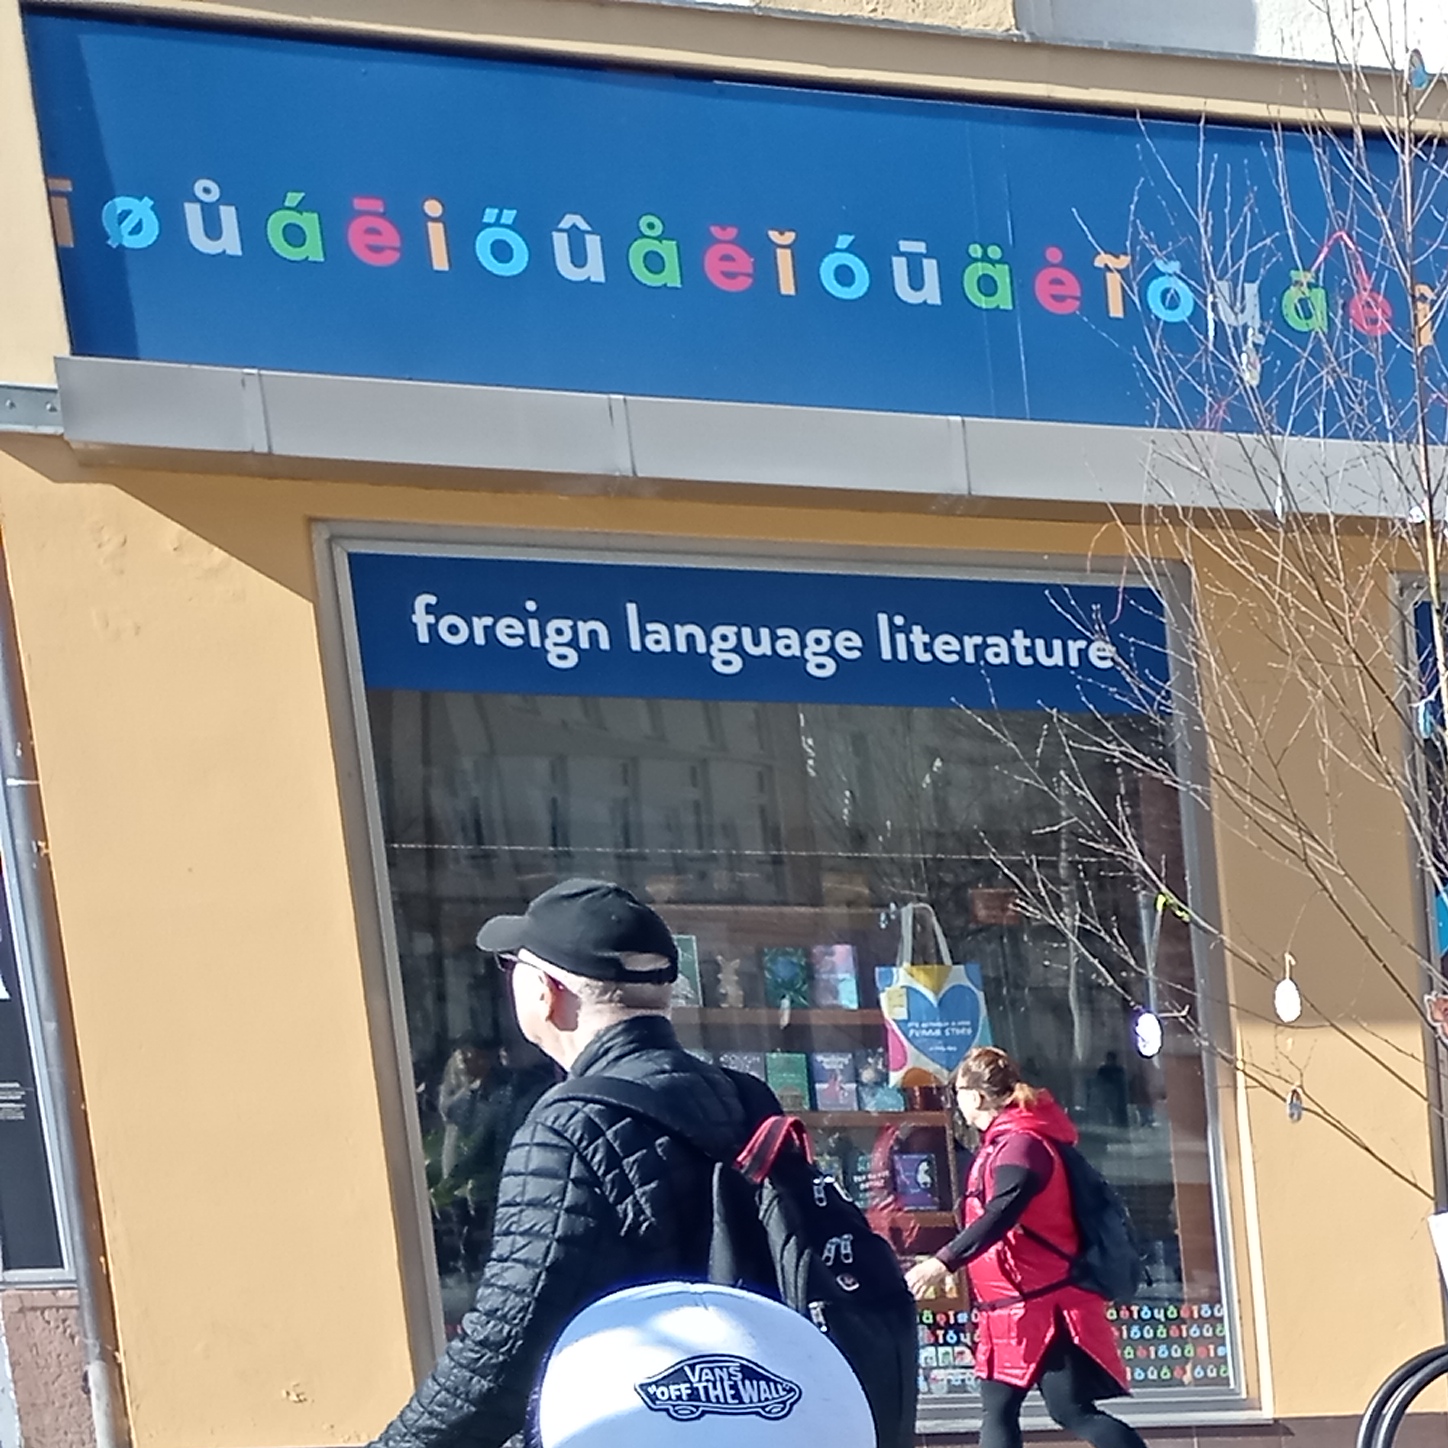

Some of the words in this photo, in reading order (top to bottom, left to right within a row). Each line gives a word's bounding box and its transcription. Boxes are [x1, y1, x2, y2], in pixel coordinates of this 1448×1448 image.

[411, 593, 611, 669] foreign
[626, 602, 864, 677] language
[876, 612, 1116, 669] literature
[683, 1362, 743, 1384] VANS
[693, 1380, 739, 1404] THE
